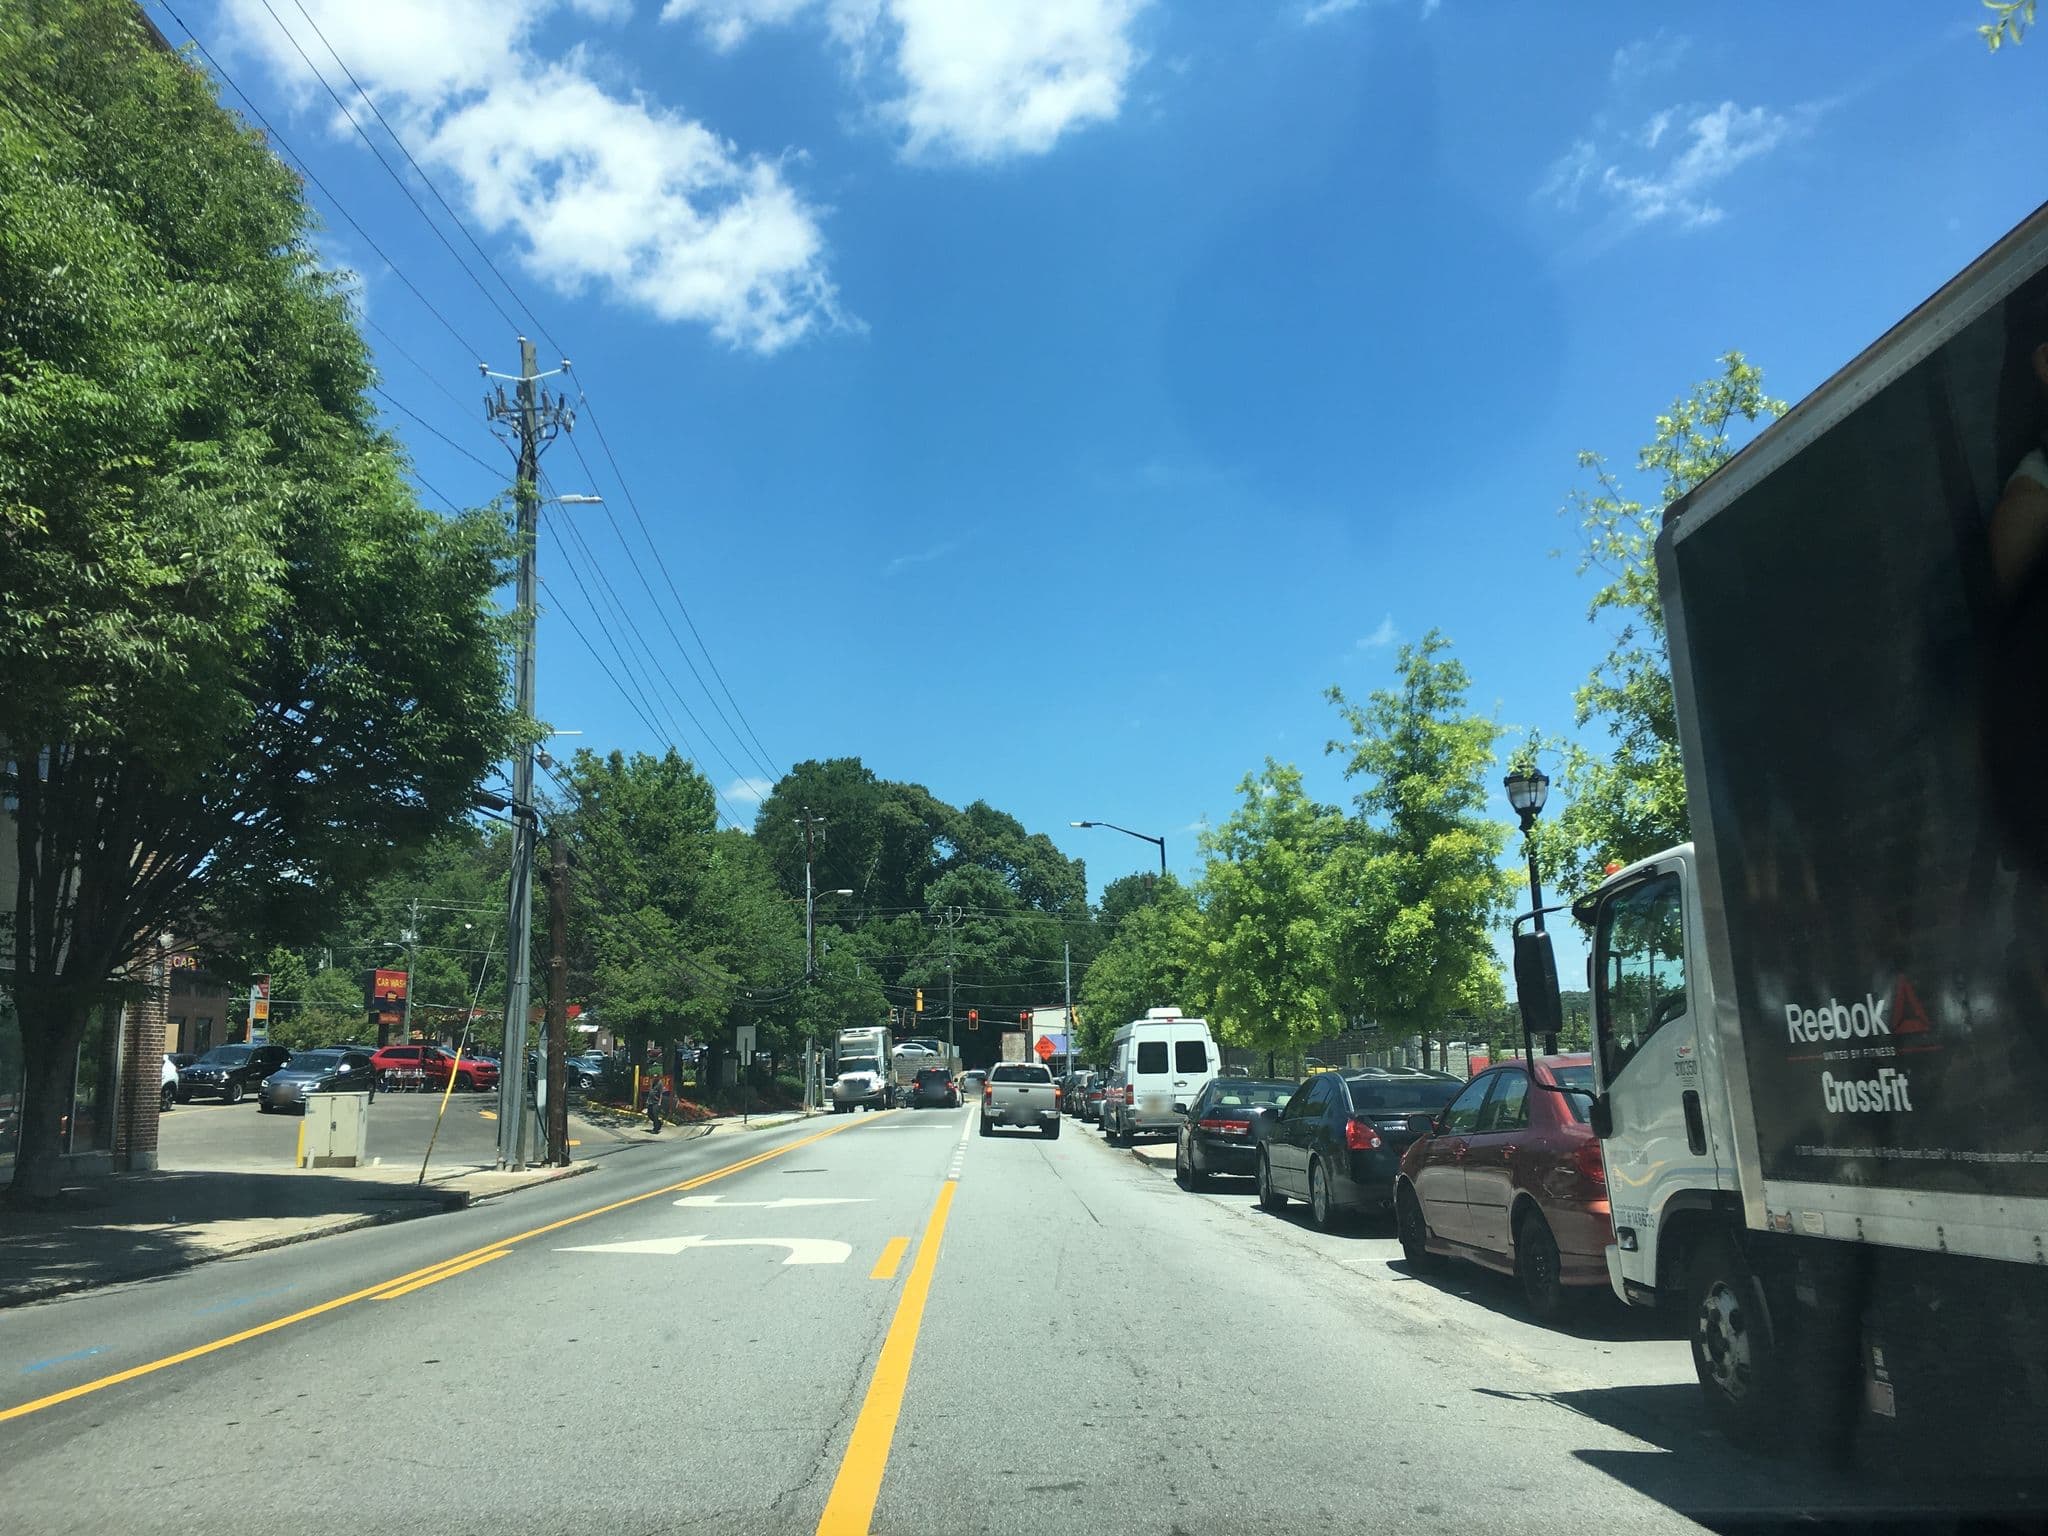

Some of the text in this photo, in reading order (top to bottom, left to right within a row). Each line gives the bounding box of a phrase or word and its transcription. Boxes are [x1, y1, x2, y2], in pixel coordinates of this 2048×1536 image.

[376, 977, 389, 987] CAR
[1785, 993, 1891, 1043] Reebok
[1822, 1068, 1913, 1112] CrossFit
